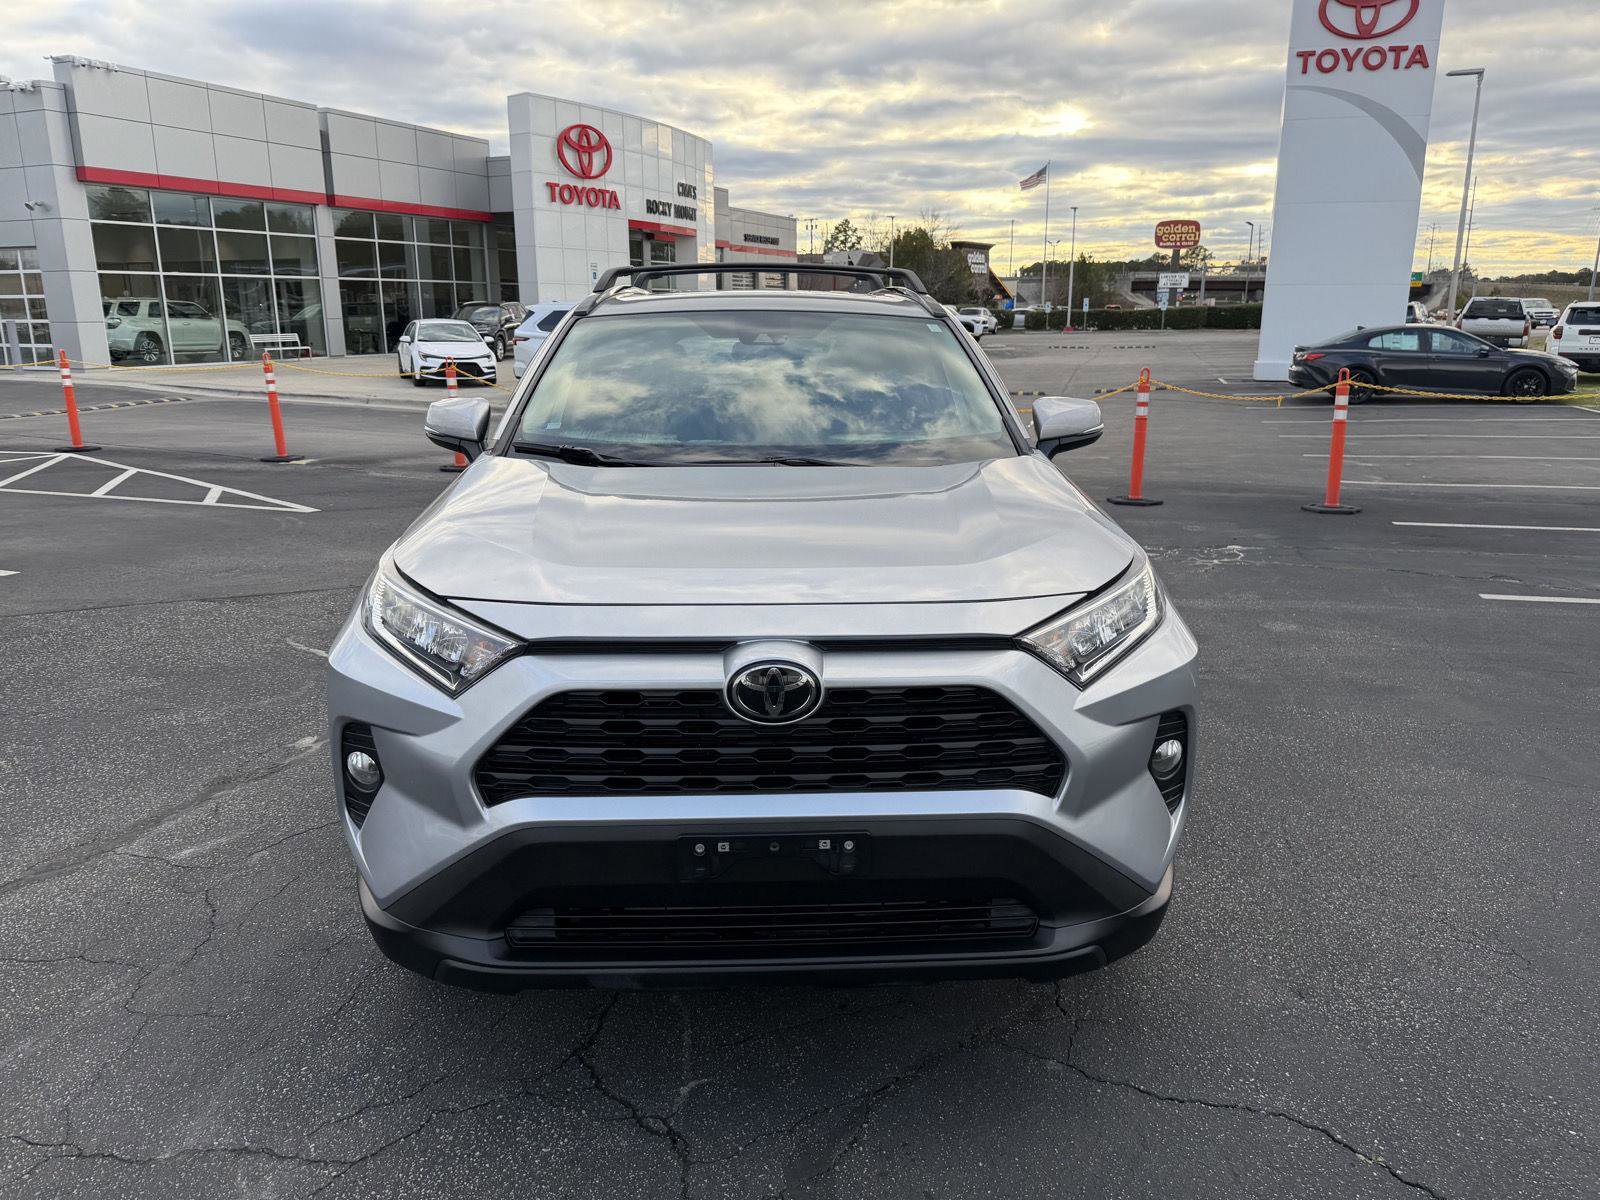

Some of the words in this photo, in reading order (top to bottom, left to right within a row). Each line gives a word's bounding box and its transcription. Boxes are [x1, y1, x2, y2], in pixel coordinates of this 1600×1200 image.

[1296, 44, 1430, 75] TOYOTA
[545, 181, 621, 210] TOYOTA
[646, 198, 672, 217] ROCKY
[673, 203, 697, 222] MOUNT
[1156, 224, 1196, 236] golden
[1162, 231, 1199, 241] corral
